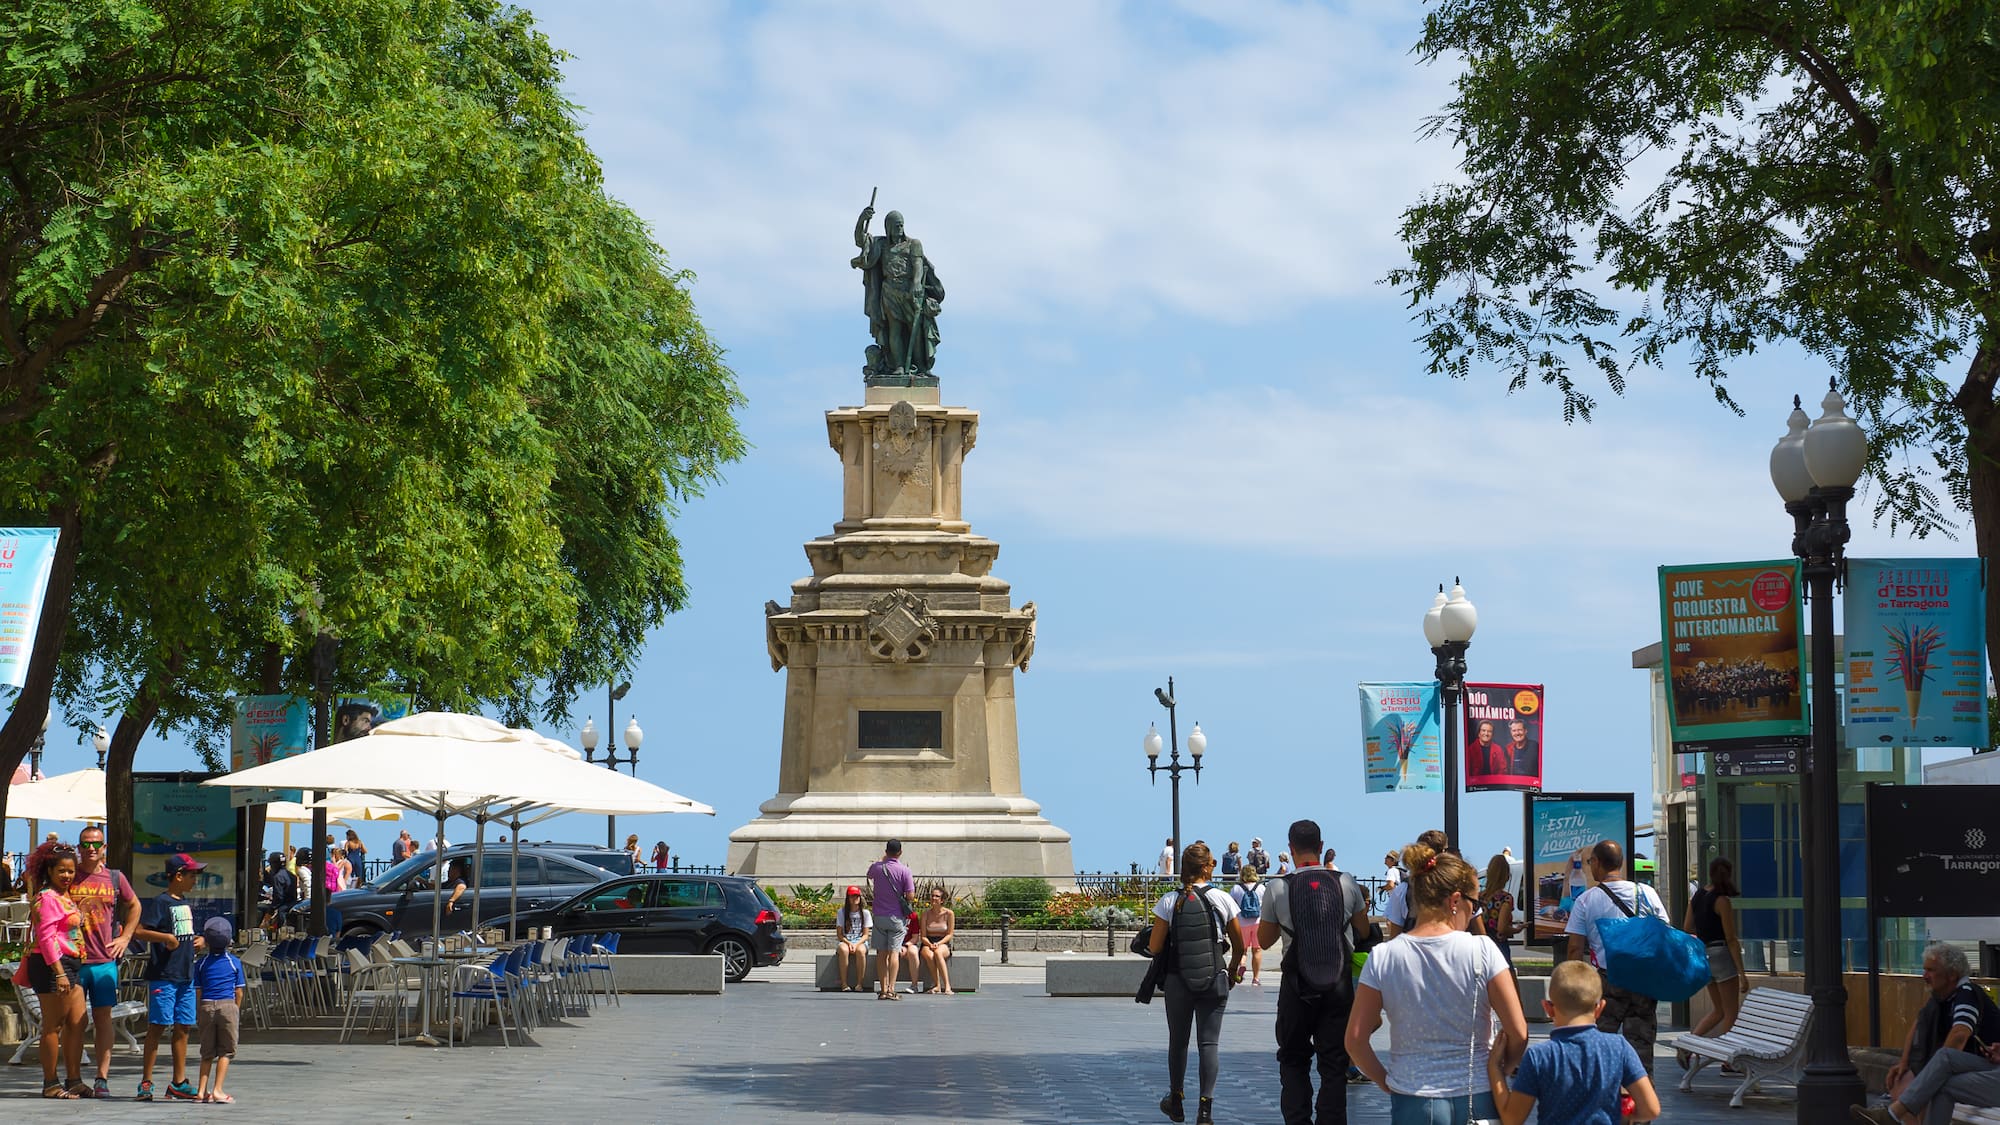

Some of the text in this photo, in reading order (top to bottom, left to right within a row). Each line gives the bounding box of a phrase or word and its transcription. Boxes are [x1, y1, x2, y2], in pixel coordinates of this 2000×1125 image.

[1878, 570, 1949, 584] FESTIVAL
[1673, 580, 1704, 598] JOVE
[1877, 583, 1948, 598] d'ESTIU
[1673, 597, 1748, 617] ORQUESTRA
[1890, 600, 1949, 610] Tarragona
[1674, 615, 1779, 639] INTERCOMARCAL
[1380, 697, 1420, 705] d'ESTIU
[1469, 691, 1488, 705] DÚO
[1469, 705, 1515, 720] DINÁMICO
